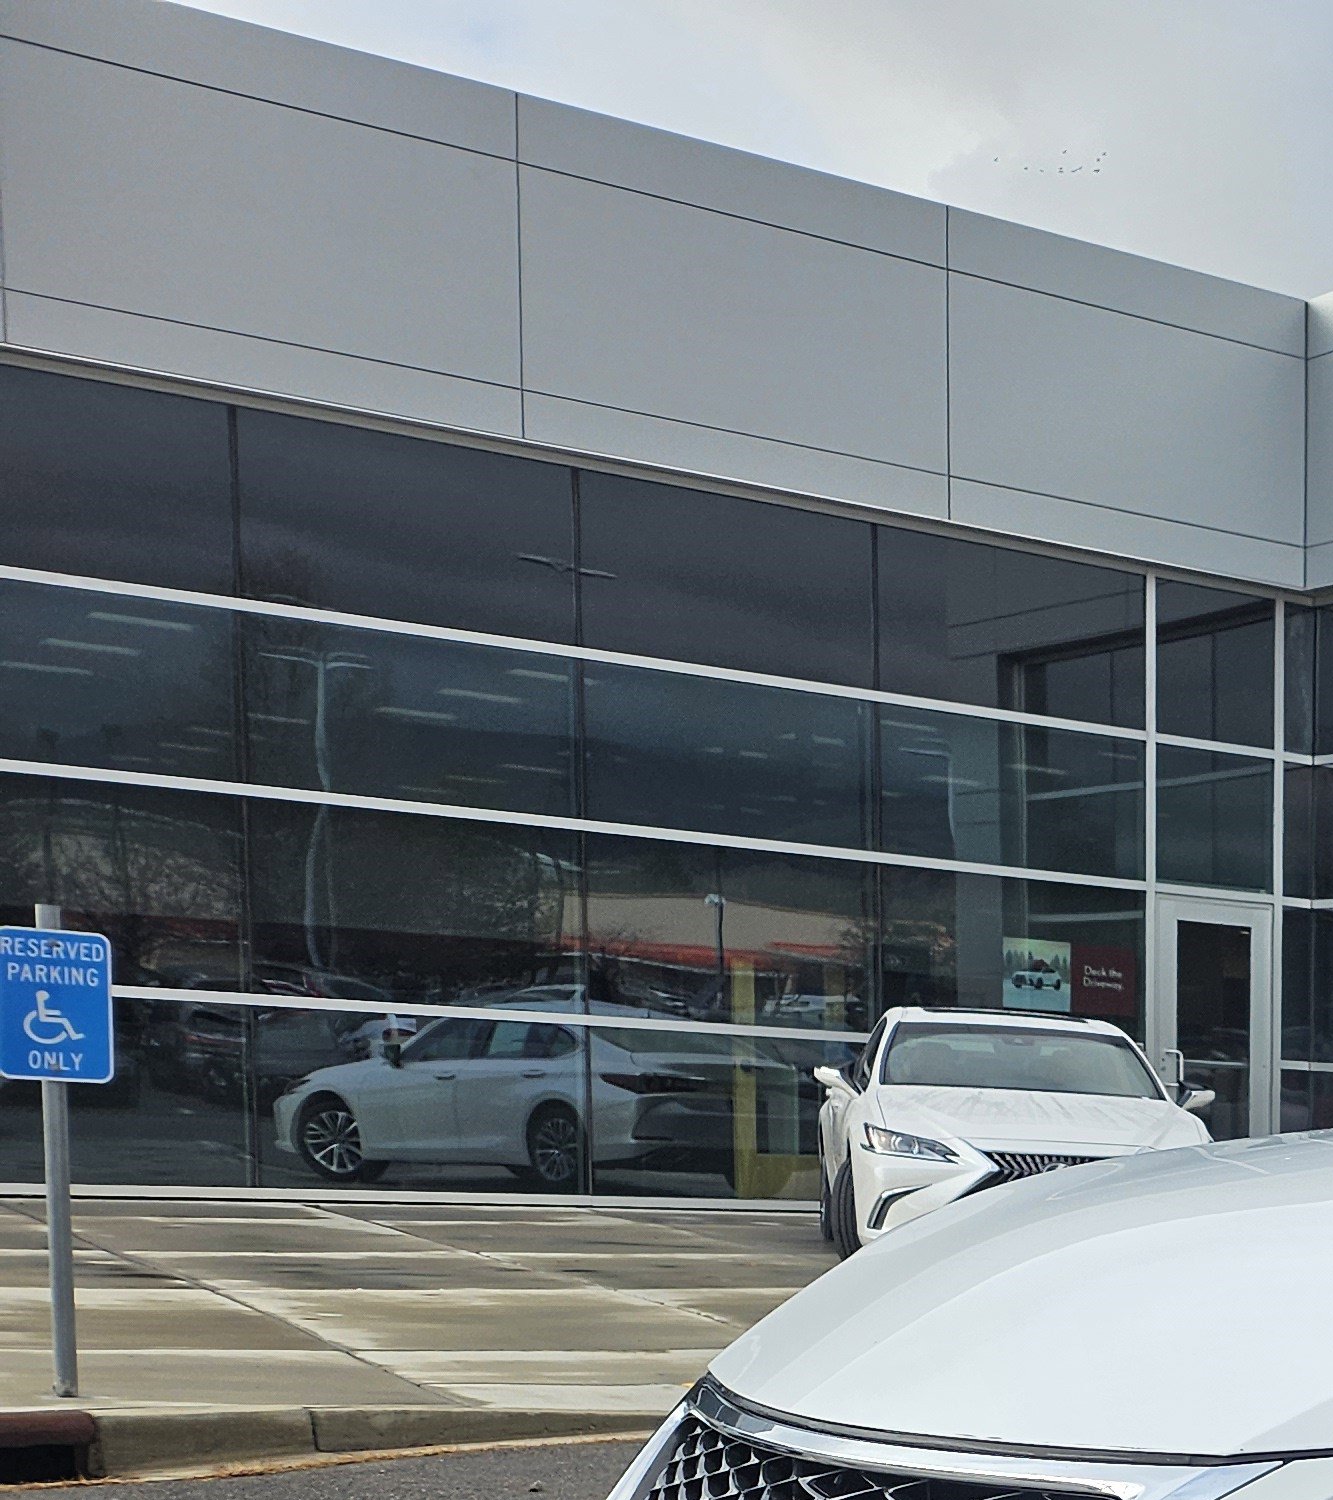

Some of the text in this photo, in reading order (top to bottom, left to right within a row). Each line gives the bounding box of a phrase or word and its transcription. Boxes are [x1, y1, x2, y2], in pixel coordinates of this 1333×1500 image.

[0, 936, 105, 963] RESERVED
[6, 962, 100, 987] PARKING
[28, 1050, 84, 1072] ONLY
